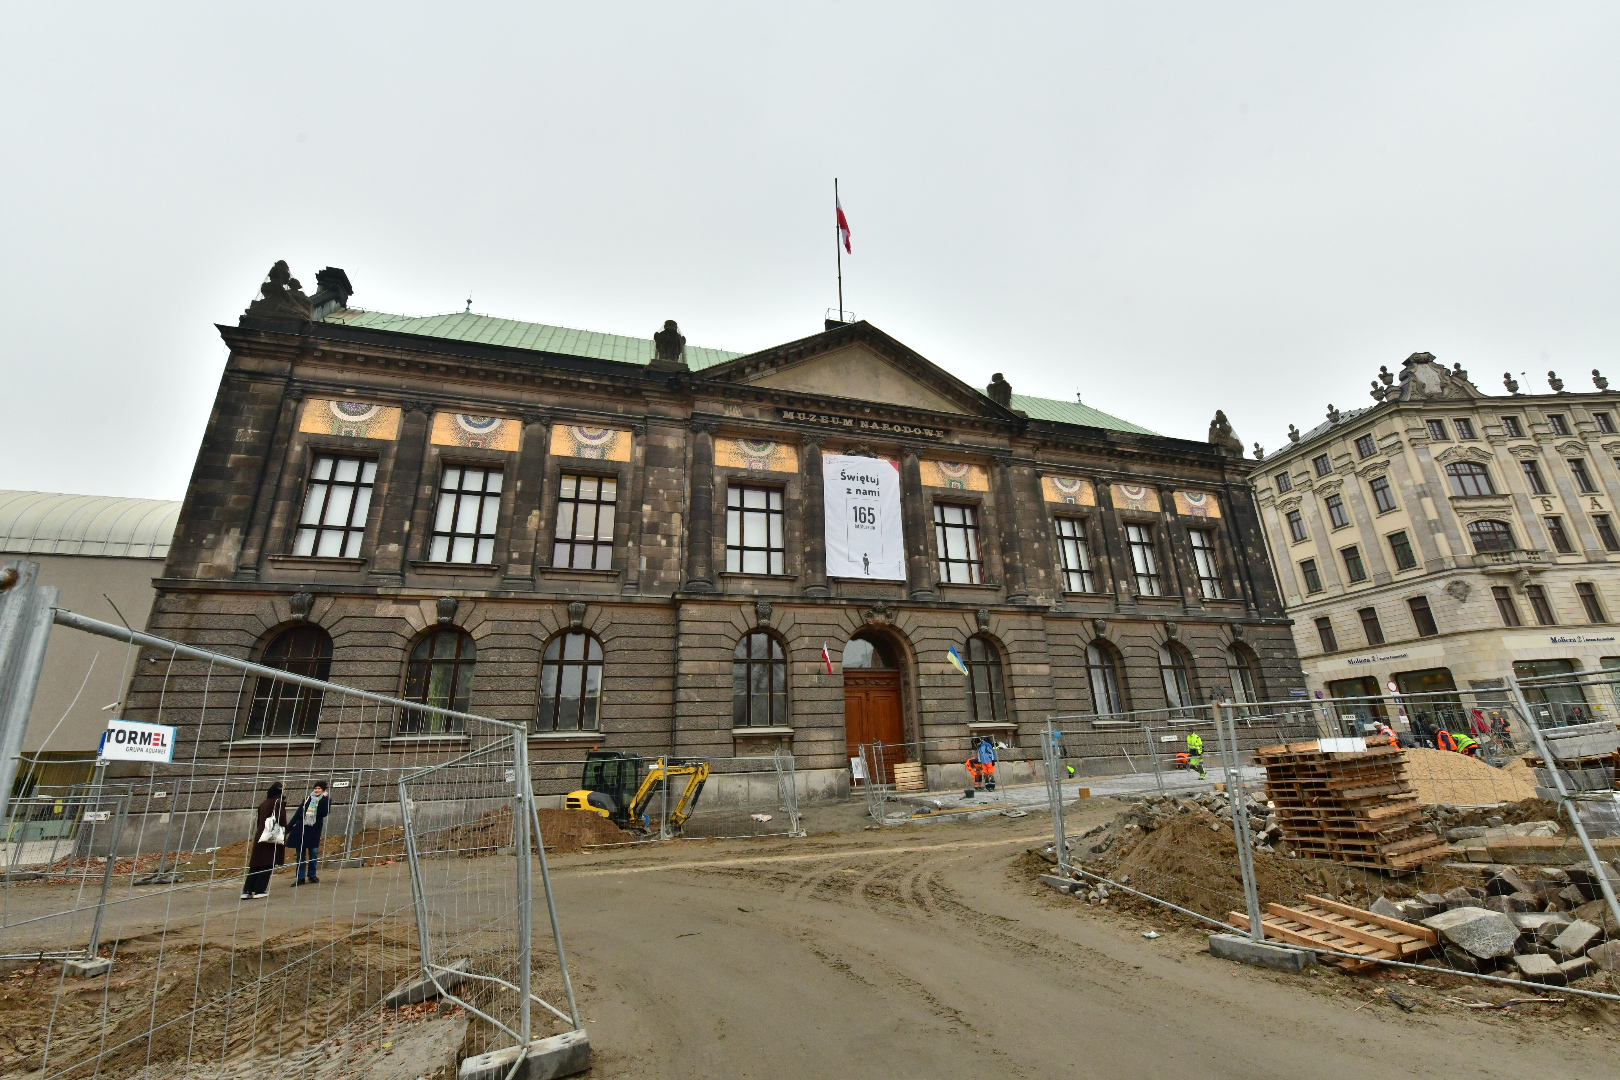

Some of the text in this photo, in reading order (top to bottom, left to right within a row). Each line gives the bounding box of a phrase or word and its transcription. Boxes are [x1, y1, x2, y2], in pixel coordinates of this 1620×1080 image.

[782, 410, 944, 438] MUZEUM NARODOWE
[840, 468, 880, 486] Świętuj
[846, 487, 881, 497] z nami
[852, 505, 876, 524] 165
[106, 728, 167, 747] TORMEL
